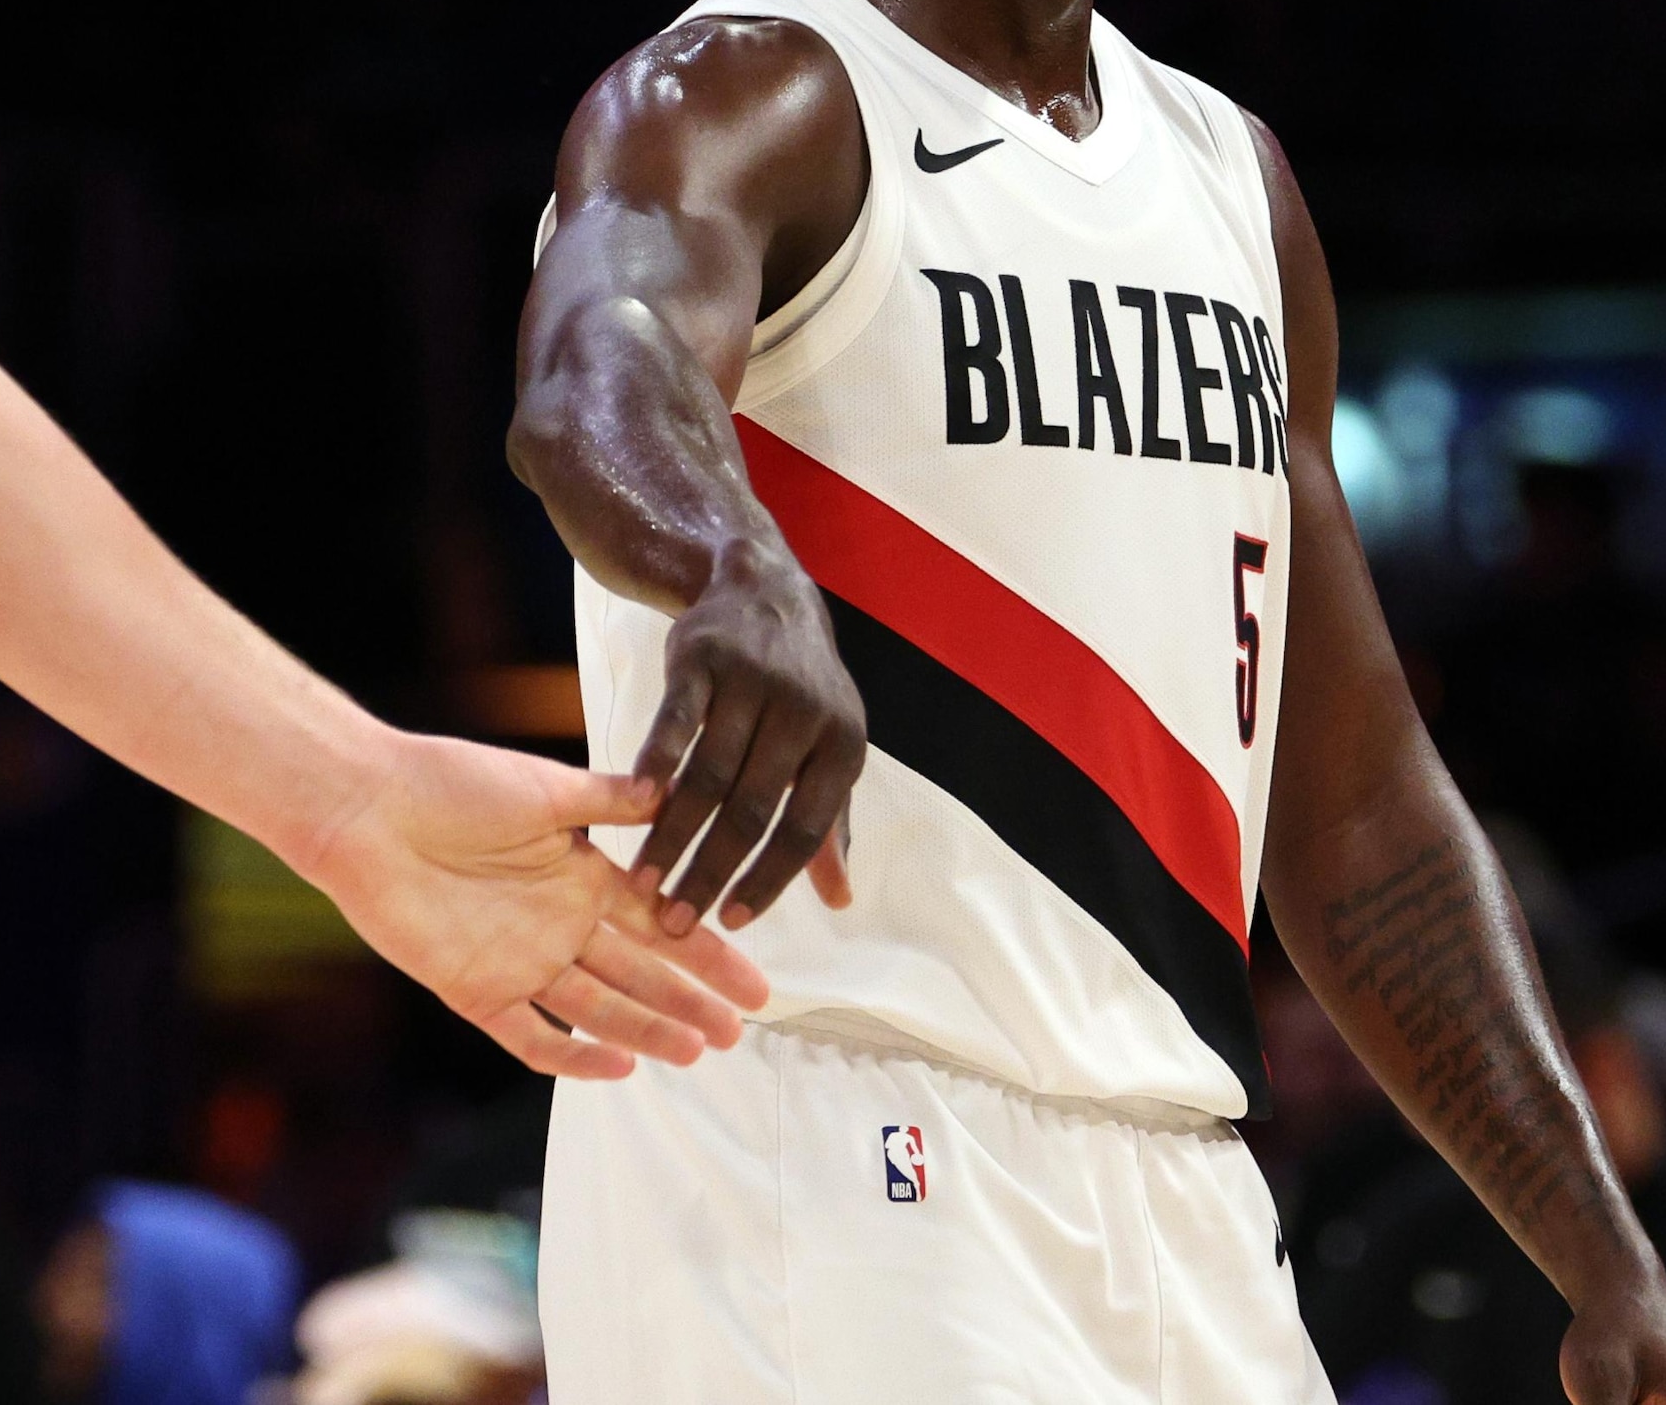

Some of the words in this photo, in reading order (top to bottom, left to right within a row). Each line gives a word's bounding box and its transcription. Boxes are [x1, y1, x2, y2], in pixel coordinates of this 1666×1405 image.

[920, 269, 1289, 480] BLAZERS
[1234, 531, 1268, 748] 5
[891, 1182, 913, 1199] NBA
